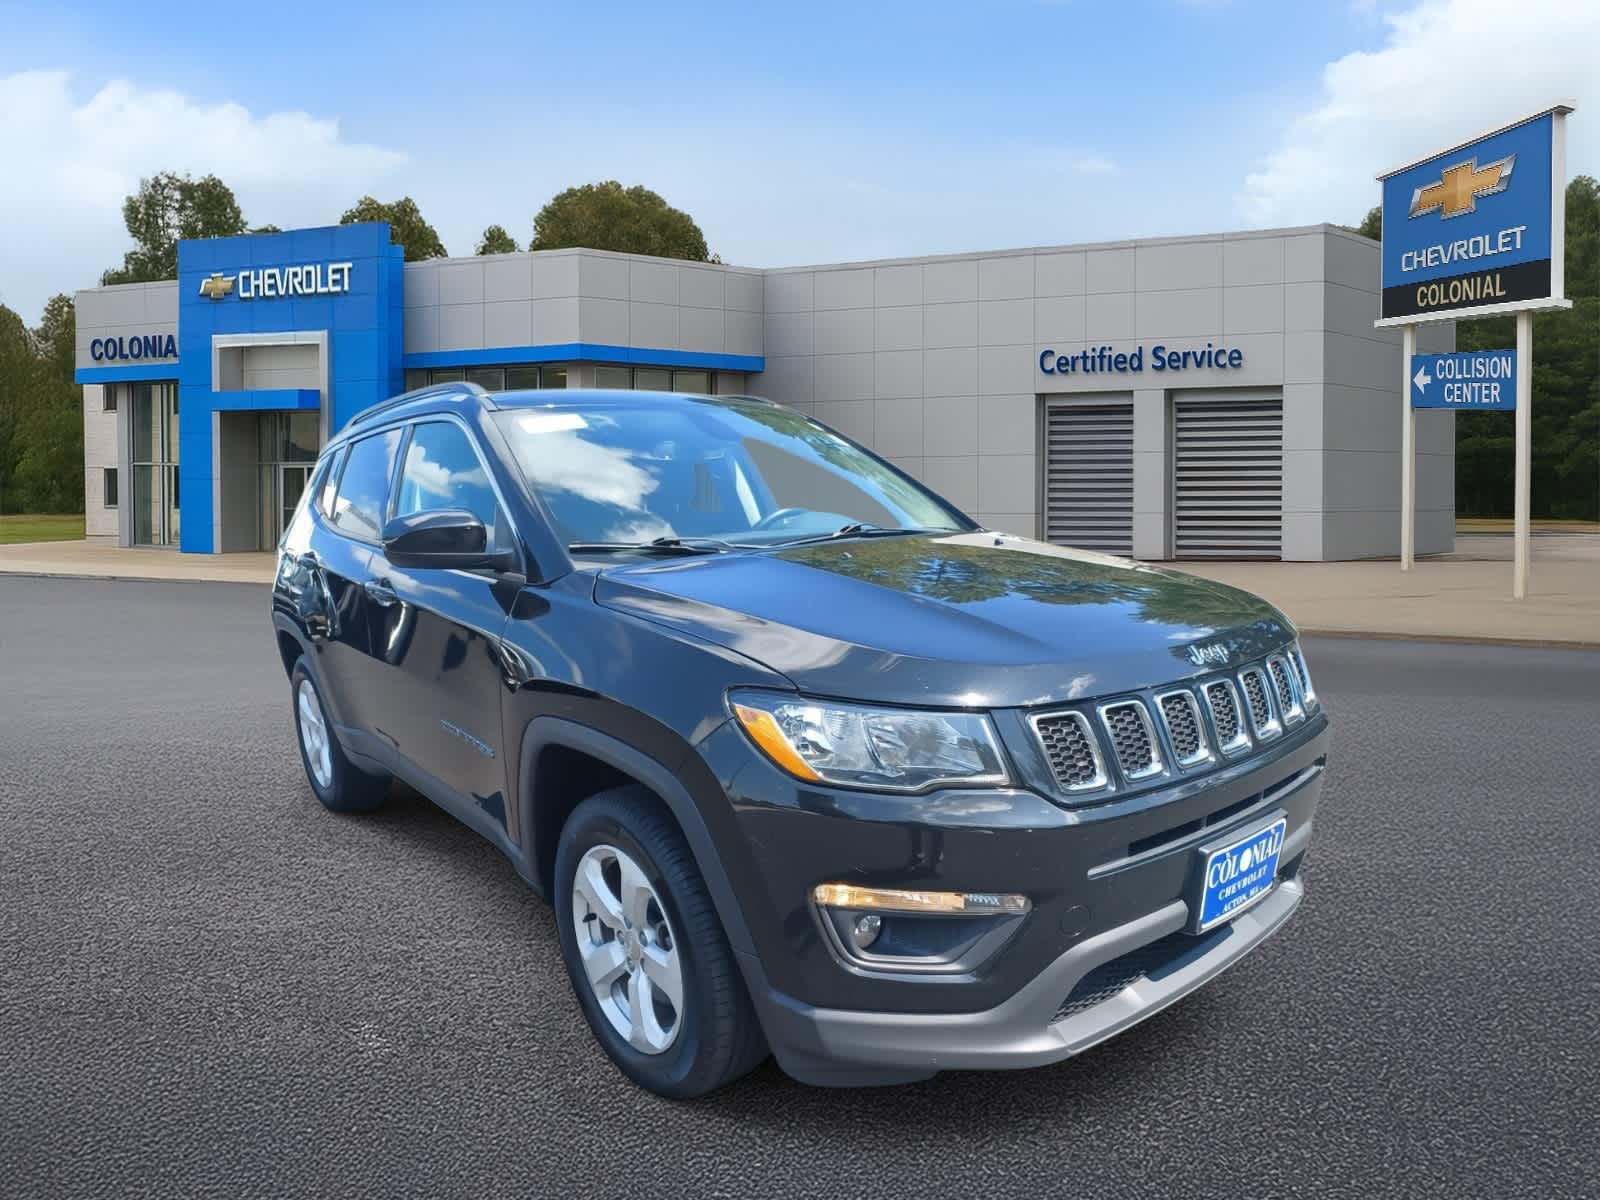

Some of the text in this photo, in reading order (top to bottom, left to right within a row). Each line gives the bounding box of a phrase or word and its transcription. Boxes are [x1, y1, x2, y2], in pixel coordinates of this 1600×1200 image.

[1401, 225, 1527, 272] CHEVROLET
[238, 261, 353, 299] CHEVROLET
[1416, 273, 1506, 307] COLONIAL
[1039, 343, 1243, 375] Certified Service
[1436, 355, 1512, 380] COLLISION
[1444, 381, 1501, 404] CENTER
[1218, 864, 1269, 901] CHEVROLET
